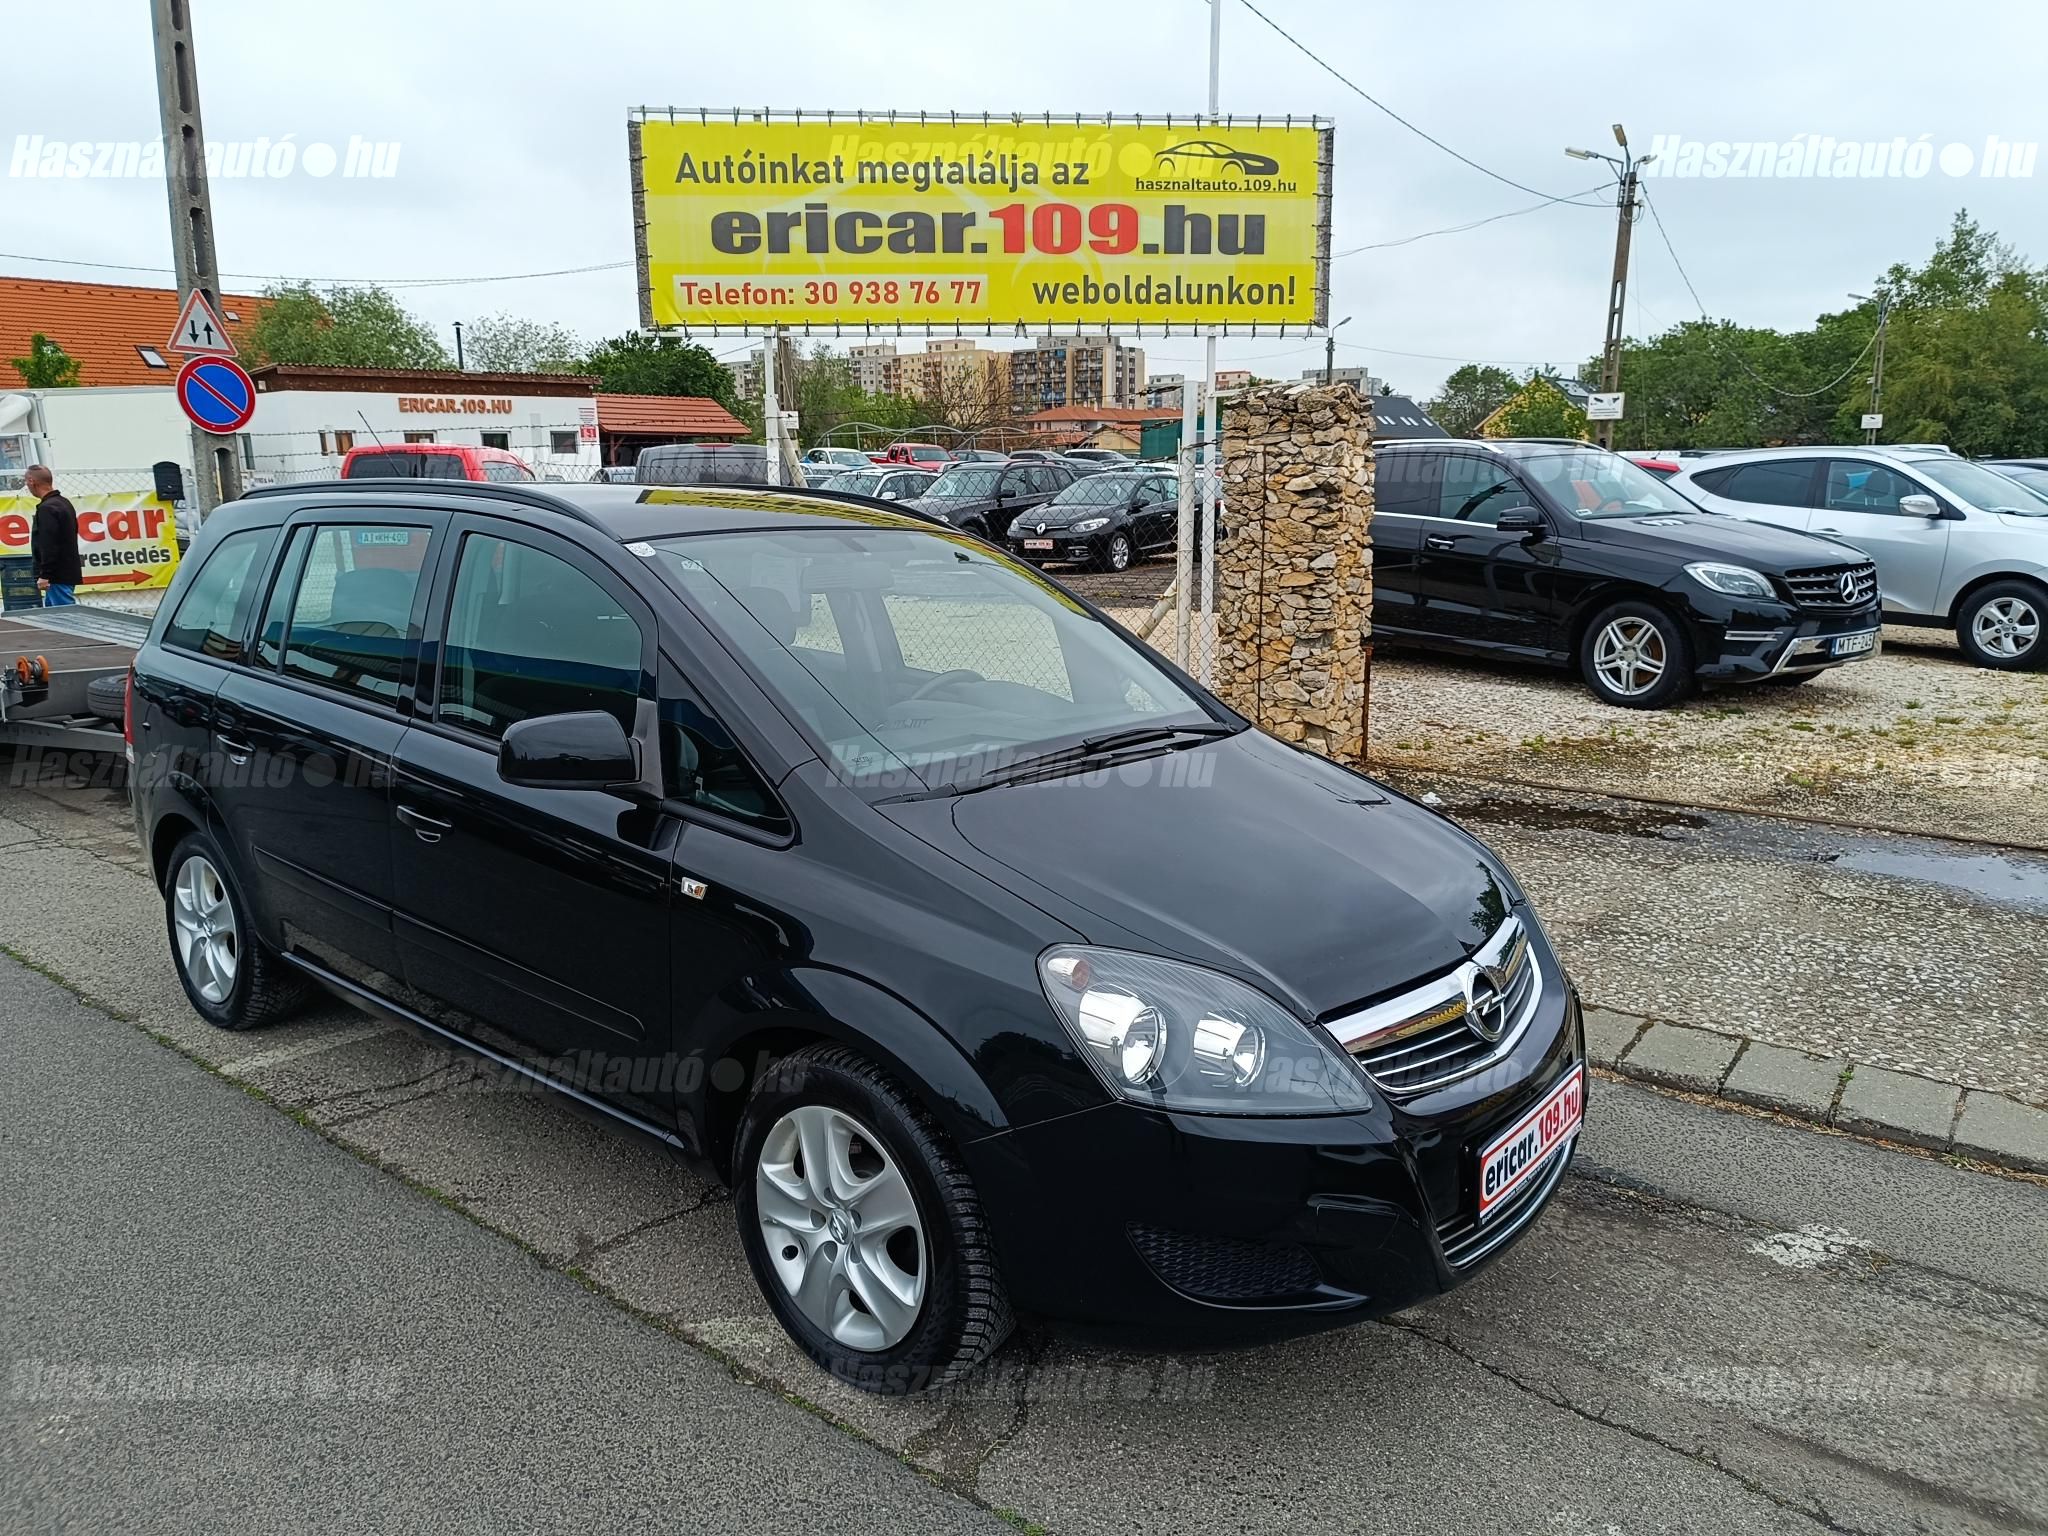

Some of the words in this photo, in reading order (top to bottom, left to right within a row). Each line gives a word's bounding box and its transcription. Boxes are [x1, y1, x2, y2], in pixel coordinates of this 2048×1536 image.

[674, 149, 844, 184] Autóinkat
[857, 150, 1040, 193] megtalálja
[1051, 160, 1090, 184] az
[1135, 178, 1297, 192] hasznaltauto.109.hu
[710, 202, 1266, 256] ericar.109.hu
[680, 281, 795, 306] Telefon:
[804, 281, 838, 305] 30
[848, 281, 900, 305] 938
[909, 281, 940, 305] 76
[950, 281, 982, 305] 77
[1032, 274, 1296, 305] weboldalunkon!
[398, 397, 513, 415] ERICAR.109.HU
[0, 508, 166, 547] ecar
[80, 546, 171, 568] reskedés
[1485, 1086, 1579, 1197] ericar.109.hu
